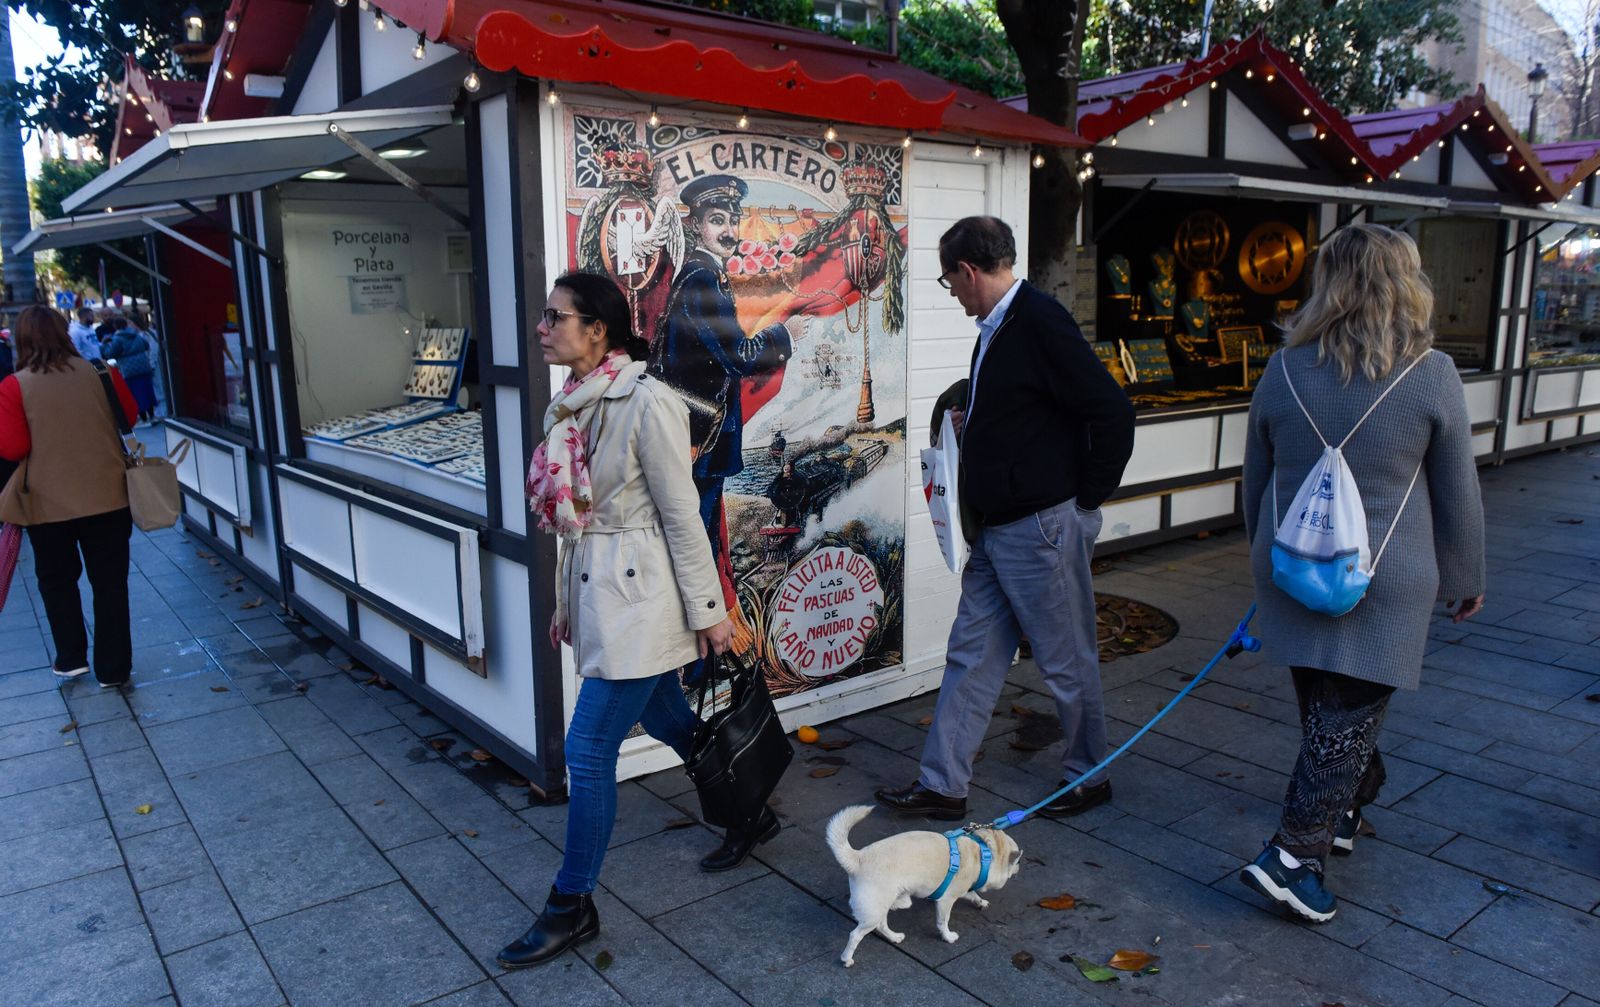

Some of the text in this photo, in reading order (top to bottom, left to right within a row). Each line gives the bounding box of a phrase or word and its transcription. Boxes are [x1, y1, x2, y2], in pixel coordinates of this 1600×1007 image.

[666, 141, 837, 194] EL CARTERO
[332, 230, 410, 246] Porcelana
[369, 245, 377, 258] y
[353, 257, 394, 273] Plata
[778, 551, 877, 613] FELICITA A USTED
[820, 577, 843, 589] LAS
[803, 587, 855, 612] PASCUAS
[823, 609, 839, 620] DE
[806, 617, 854, 642] NAVIDAD
[779, 615, 875, 670] AÑO NUEVO
[827, 638, 836, 647] Y
